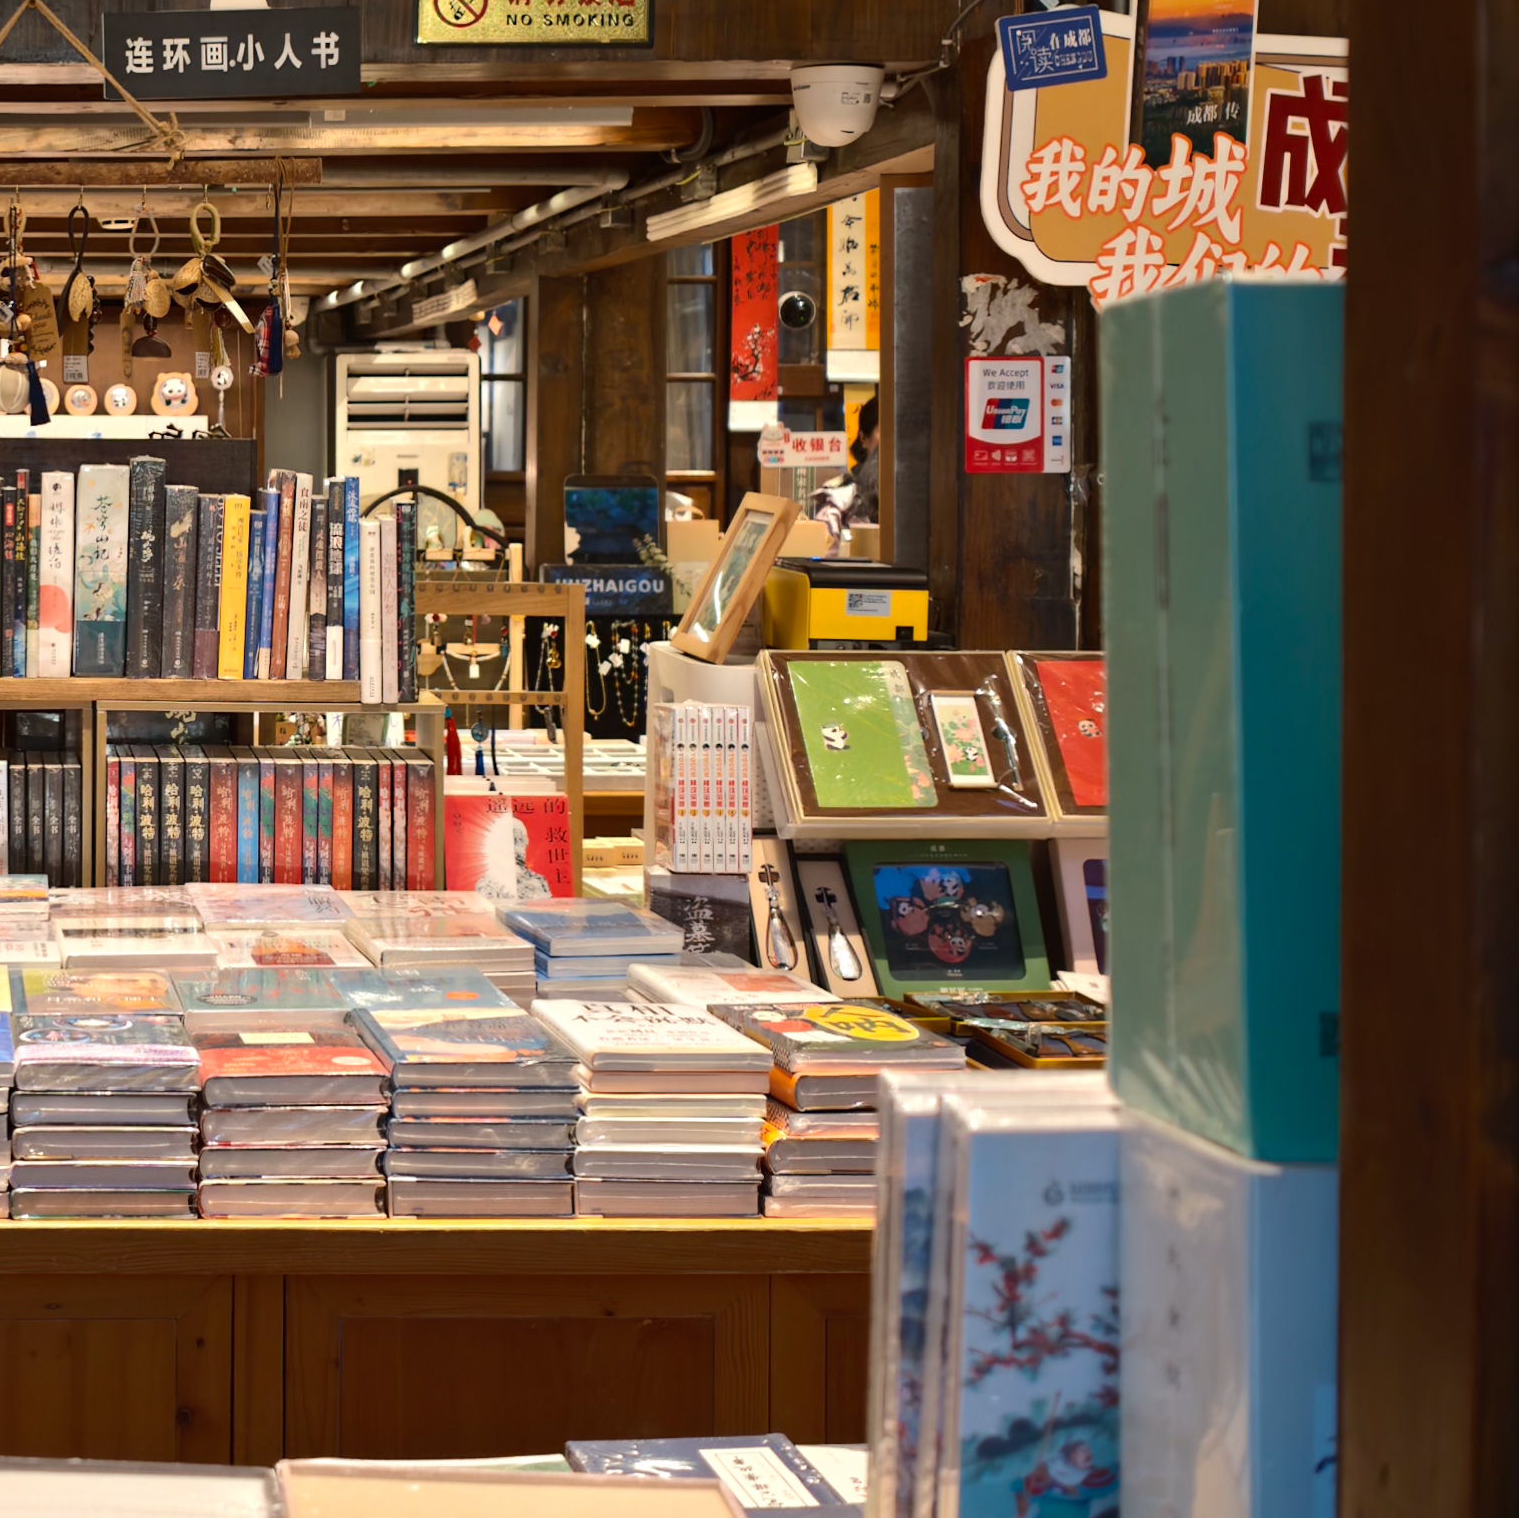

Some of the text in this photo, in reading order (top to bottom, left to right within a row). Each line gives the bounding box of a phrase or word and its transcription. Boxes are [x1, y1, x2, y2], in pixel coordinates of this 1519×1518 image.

[506, 13, 634, 27] NO SMOKING
[1022, 132, 1248, 244] 我的城
[983, 369, 1030, 378] We Accept
[987, 381, 1025, 391] 欢迎使用
[986, 405, 1027, 417] UnionPay
[792, 436, 842, 454] 收银台
[297, 486, 310, 533] 食南之徒
[329, 522, 344, 576] 流浪地球
[555, 579, 665, 593] ZHAIGOU
[486, 798, 565, 815] 遥远的
[545, 827, 571, 884] 救世主
